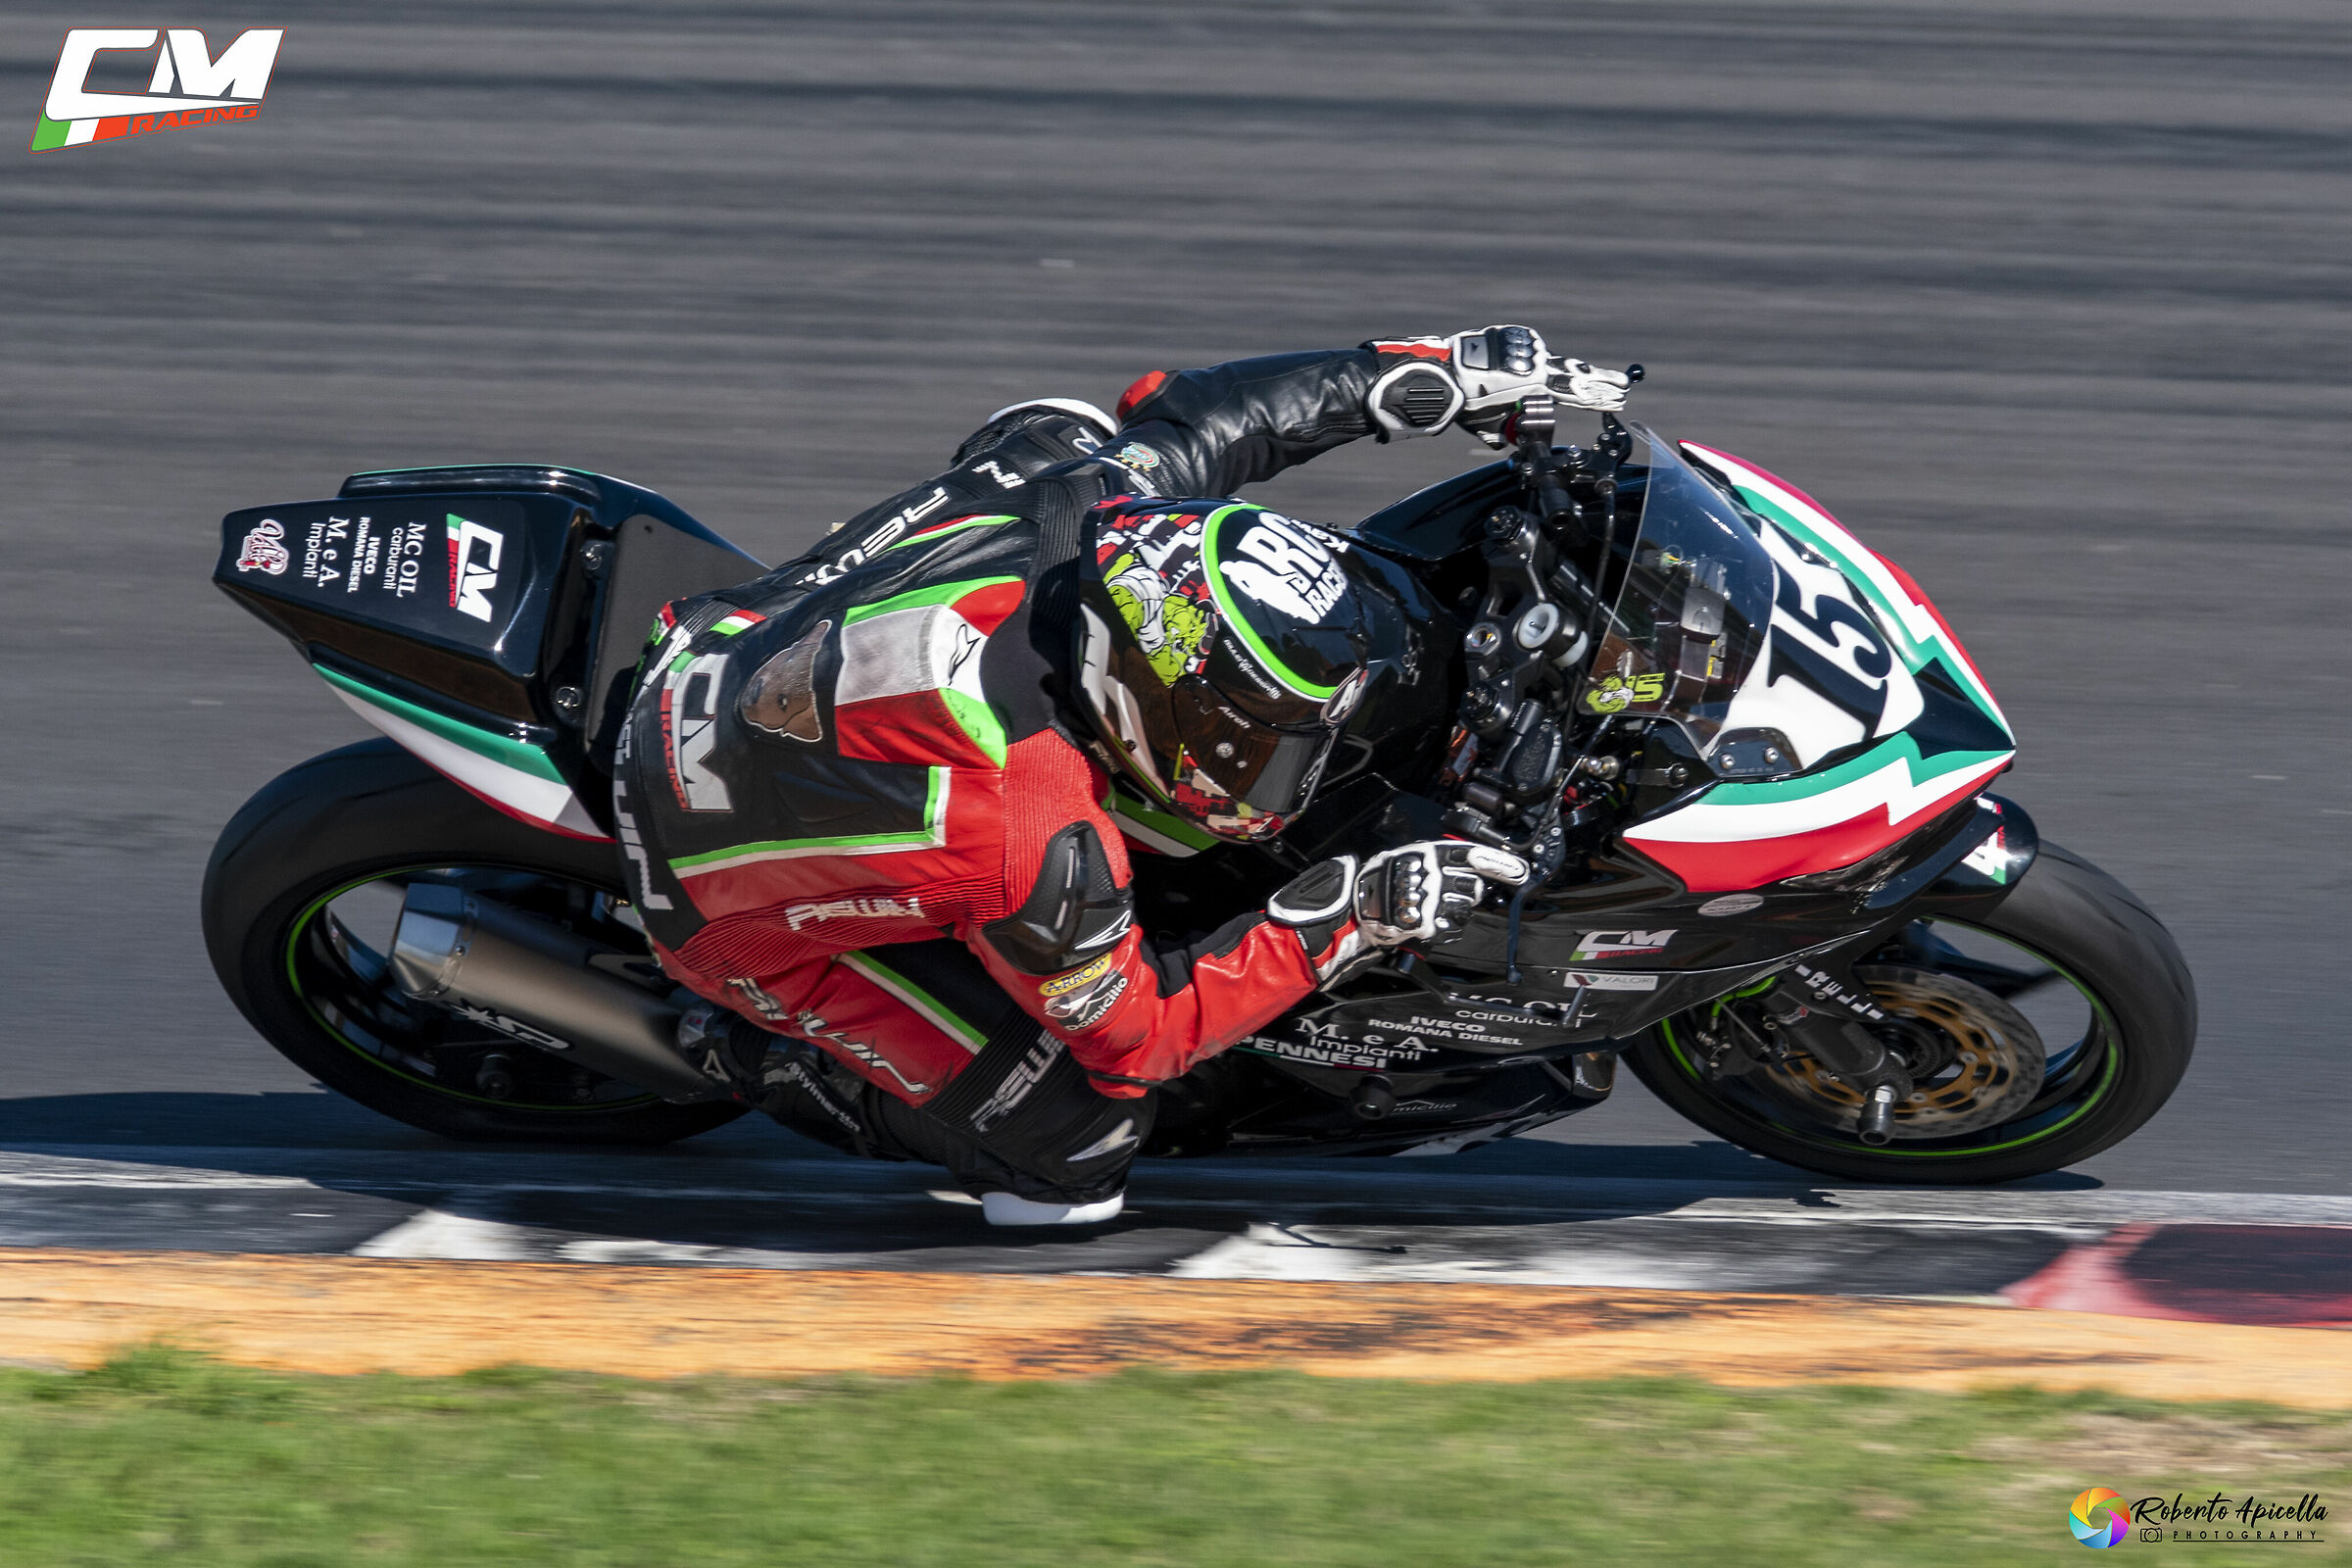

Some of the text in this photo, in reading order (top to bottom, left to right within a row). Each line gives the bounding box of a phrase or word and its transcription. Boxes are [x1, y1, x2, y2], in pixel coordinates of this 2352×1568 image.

[303, 522, 322, 579] Impianti
[347, 517, 370, 593] ROMANA DIESEL
[363, 536, 380, 575] IVECO
[383, 527, 403, 590] carburanti
[397, 522, 427, 599] MC OIL
[457, 520, 504, 622] CM
[448, 553, 459, 608] RACING
[1768, 560, 1892, 740] 15
[662, 710, 689, 810] RACING
[675, 655, 735, 811] CM
[1576, 929, 1679, 953] CM
[1610, 947, 1663, 957] RACING
[1045, 958, 1110, 994] ARROW
[1065, 975, 1130, 1032] Domicilio
[1309, 1036, 1421, 1062] Impianti
[1367, 1019, 1523, 1046] ROMANA DIESEL
[1410, 1015, 1487, 1034] IVECO
